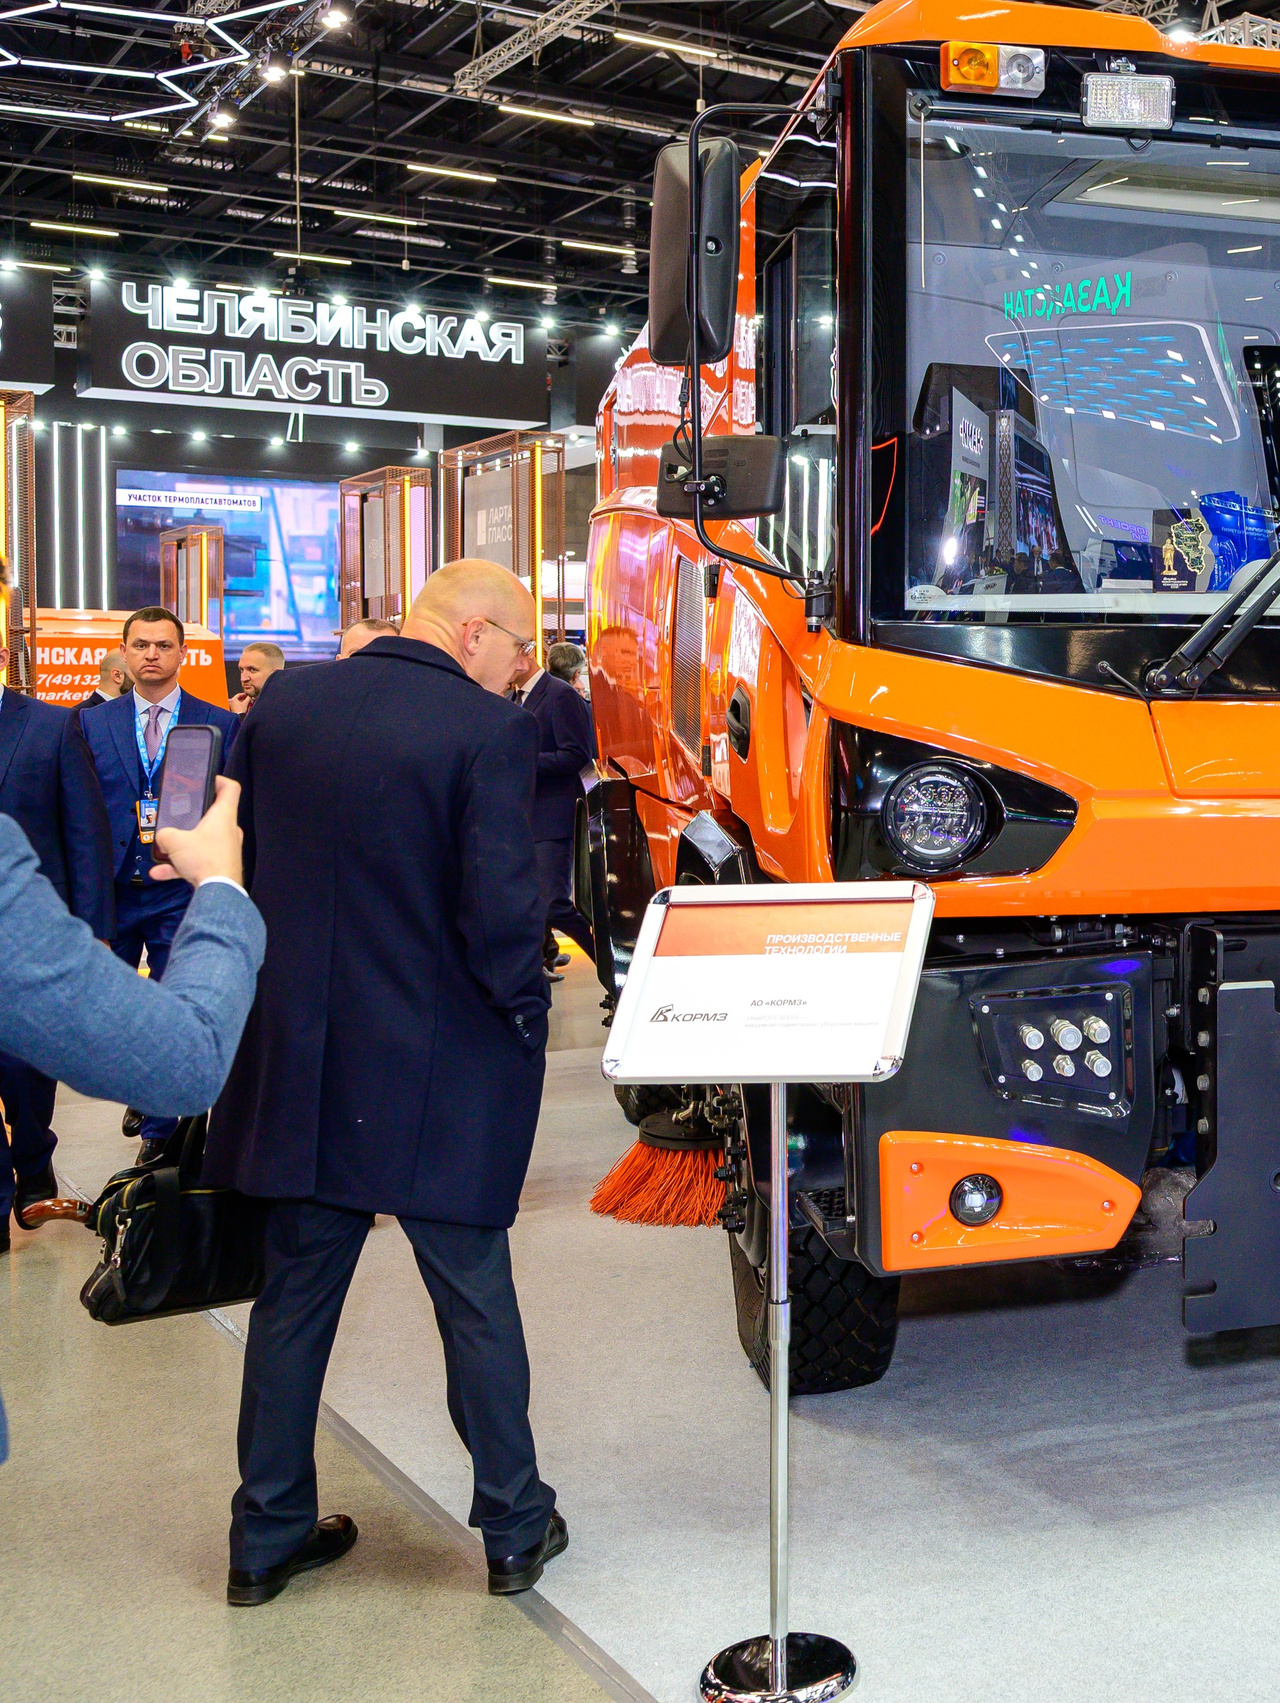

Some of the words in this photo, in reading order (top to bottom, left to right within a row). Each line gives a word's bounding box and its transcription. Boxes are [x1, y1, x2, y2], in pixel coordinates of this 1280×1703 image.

[121, 281, 525, 364] ЧЕЛЯБИНСКАЯ
[121, 342, 389, 406] ОБЛАСТЬ
[127, 493, 163, 503] УЧАСТОК
[164, 495, 257, 508] ТЕРМОПЛАСТАВТОМАТОВ
[28, 646, 108, 665] НСКАЯ
[766, 932, 903, 944] ПРОИЗВОДСТВЕННЫЕ
[764, 944, 848, 956] ТЕХНОЛОГИИ
[750, 999, 763, 1007] АО
[764, 998, 808, 1007] «КОРМЗ»
[670, 1012, 728, 1023] КОРМЗ
